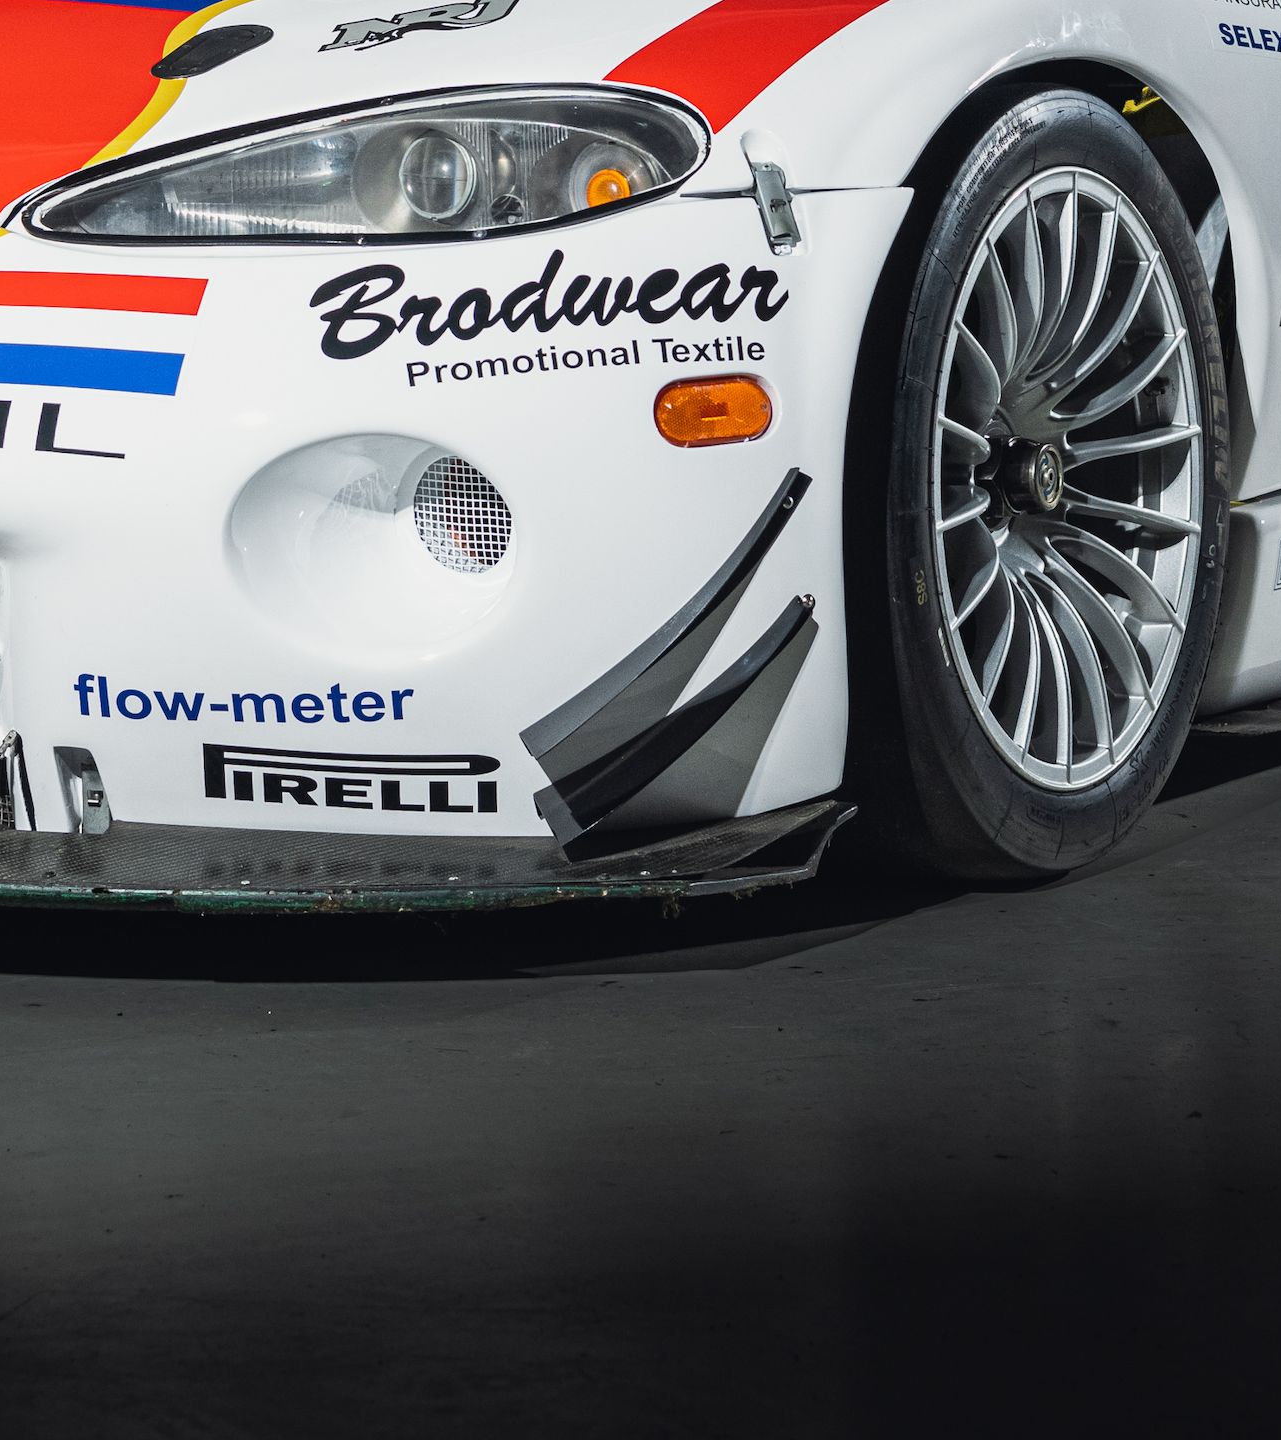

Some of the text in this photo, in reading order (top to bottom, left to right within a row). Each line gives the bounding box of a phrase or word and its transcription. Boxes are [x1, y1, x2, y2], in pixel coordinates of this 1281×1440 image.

[309, 249, 790, 360] Brodwear
[406, 334, 767, 388] Promotional Textile
[72, 672, 414, 725] flow-meter
[203, 743, 501, 813] PIRELLI
